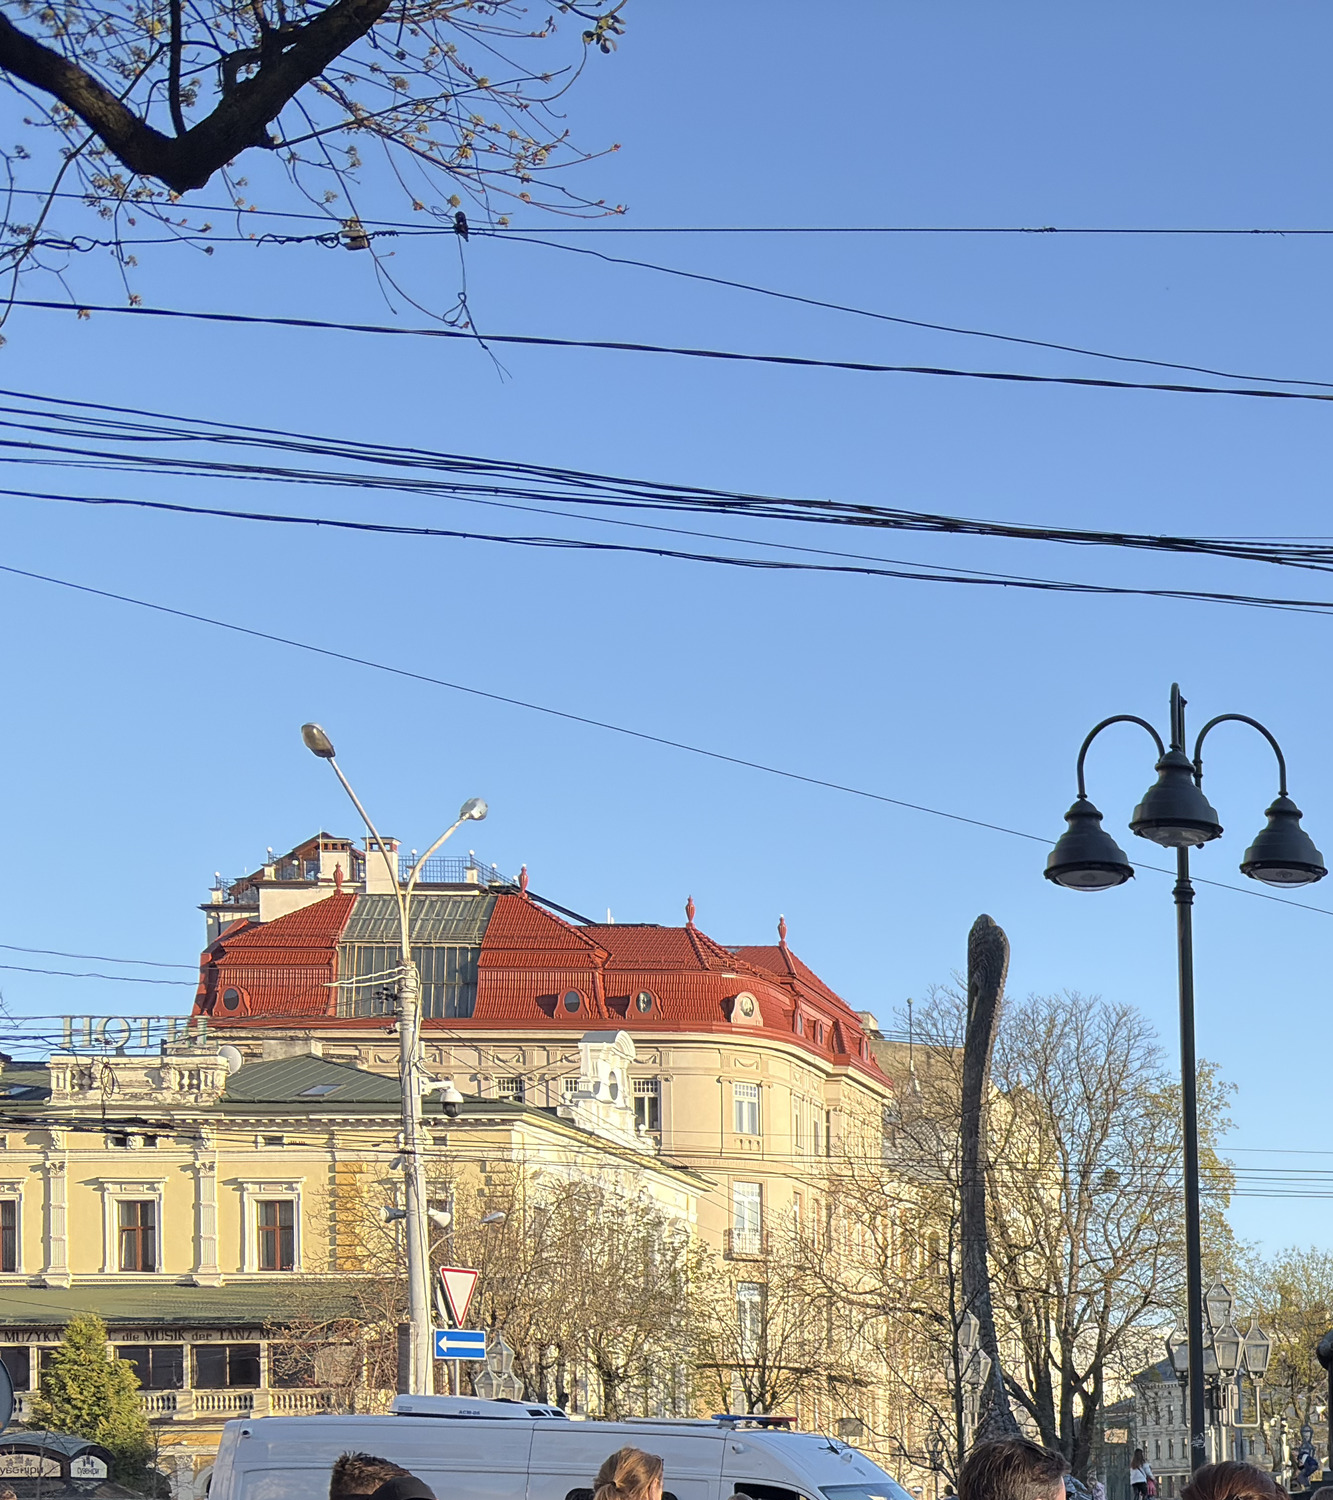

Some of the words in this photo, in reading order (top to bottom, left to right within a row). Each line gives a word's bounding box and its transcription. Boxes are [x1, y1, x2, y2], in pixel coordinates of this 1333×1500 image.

[60, 1015, 218, 1048] HOTEL
[4, 1330, 61, 1342] MUZYKA
[143, 1330, 185, 1341] MUSIK
[191, 1331, 213, 1340] der
[219, 1328, 253, 1340] TANZ
